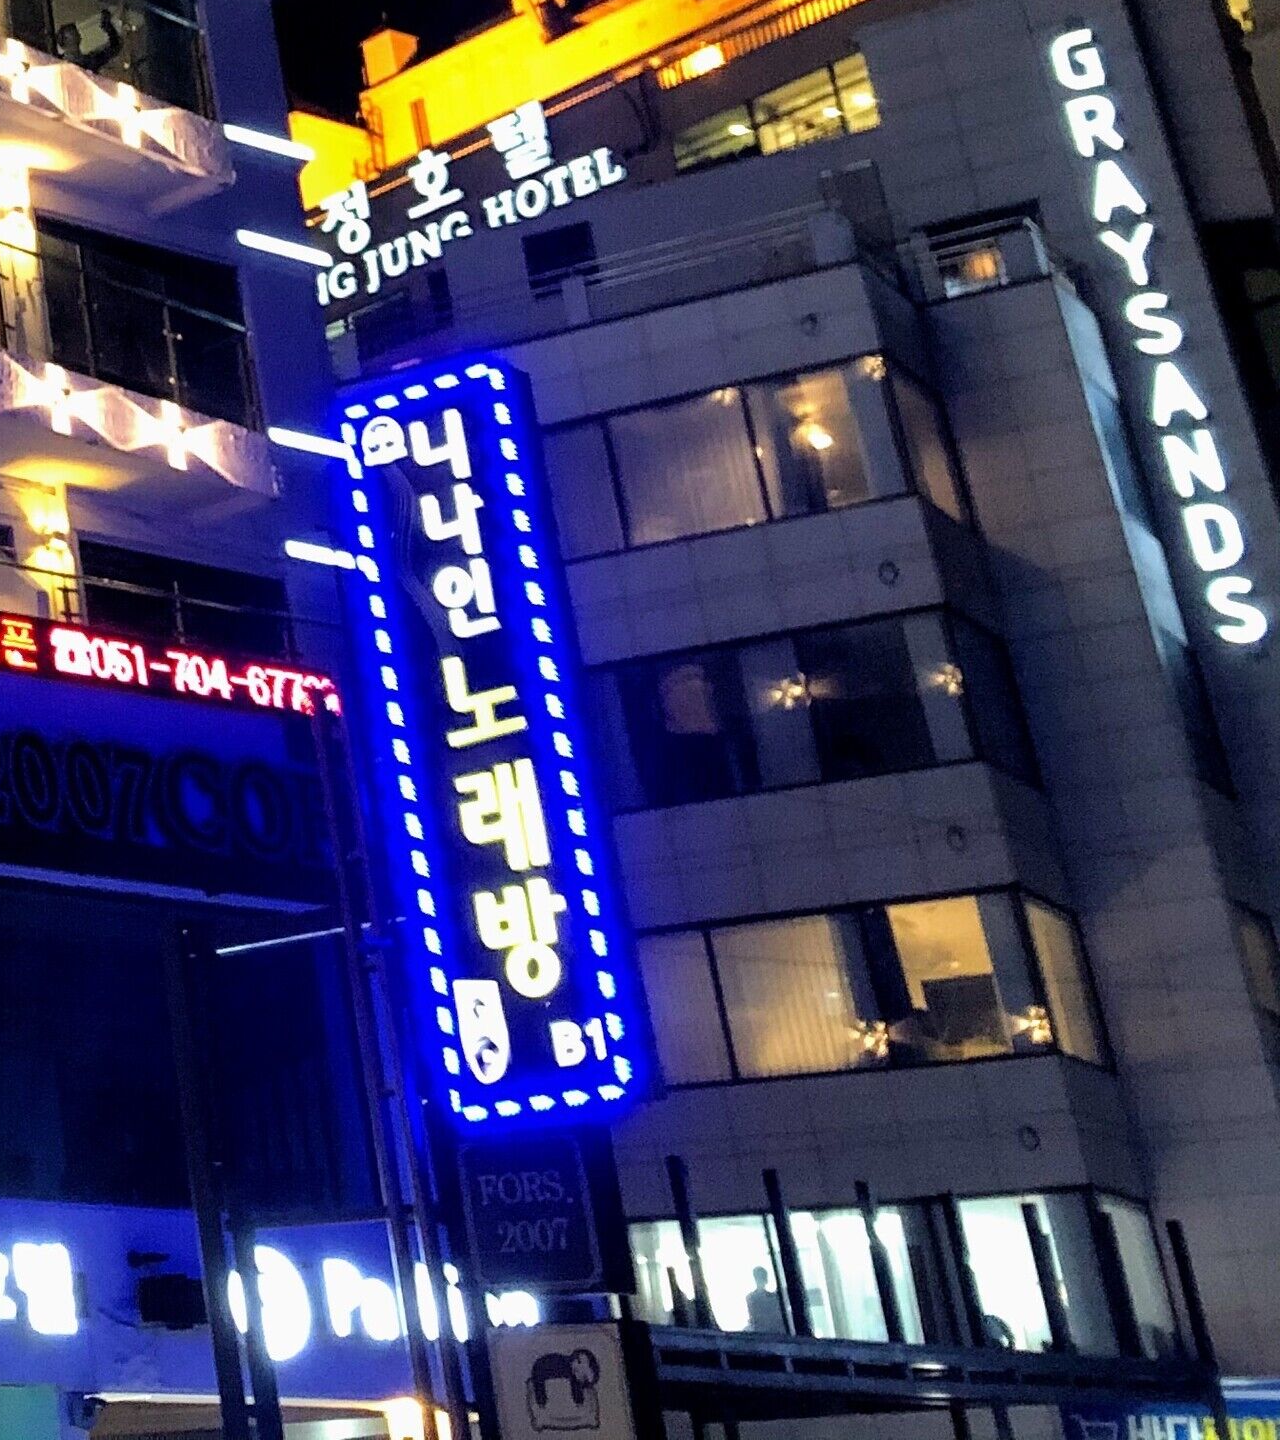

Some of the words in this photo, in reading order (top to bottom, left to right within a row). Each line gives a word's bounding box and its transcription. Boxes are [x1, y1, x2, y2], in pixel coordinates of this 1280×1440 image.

[481, 146, 629, 228] HOTEL
[1050, 27, 1269, 646] GRAYSANDS
[477, 1169, 575, 1206] FORS.
[496, 1216, 569, 1253] 2007
